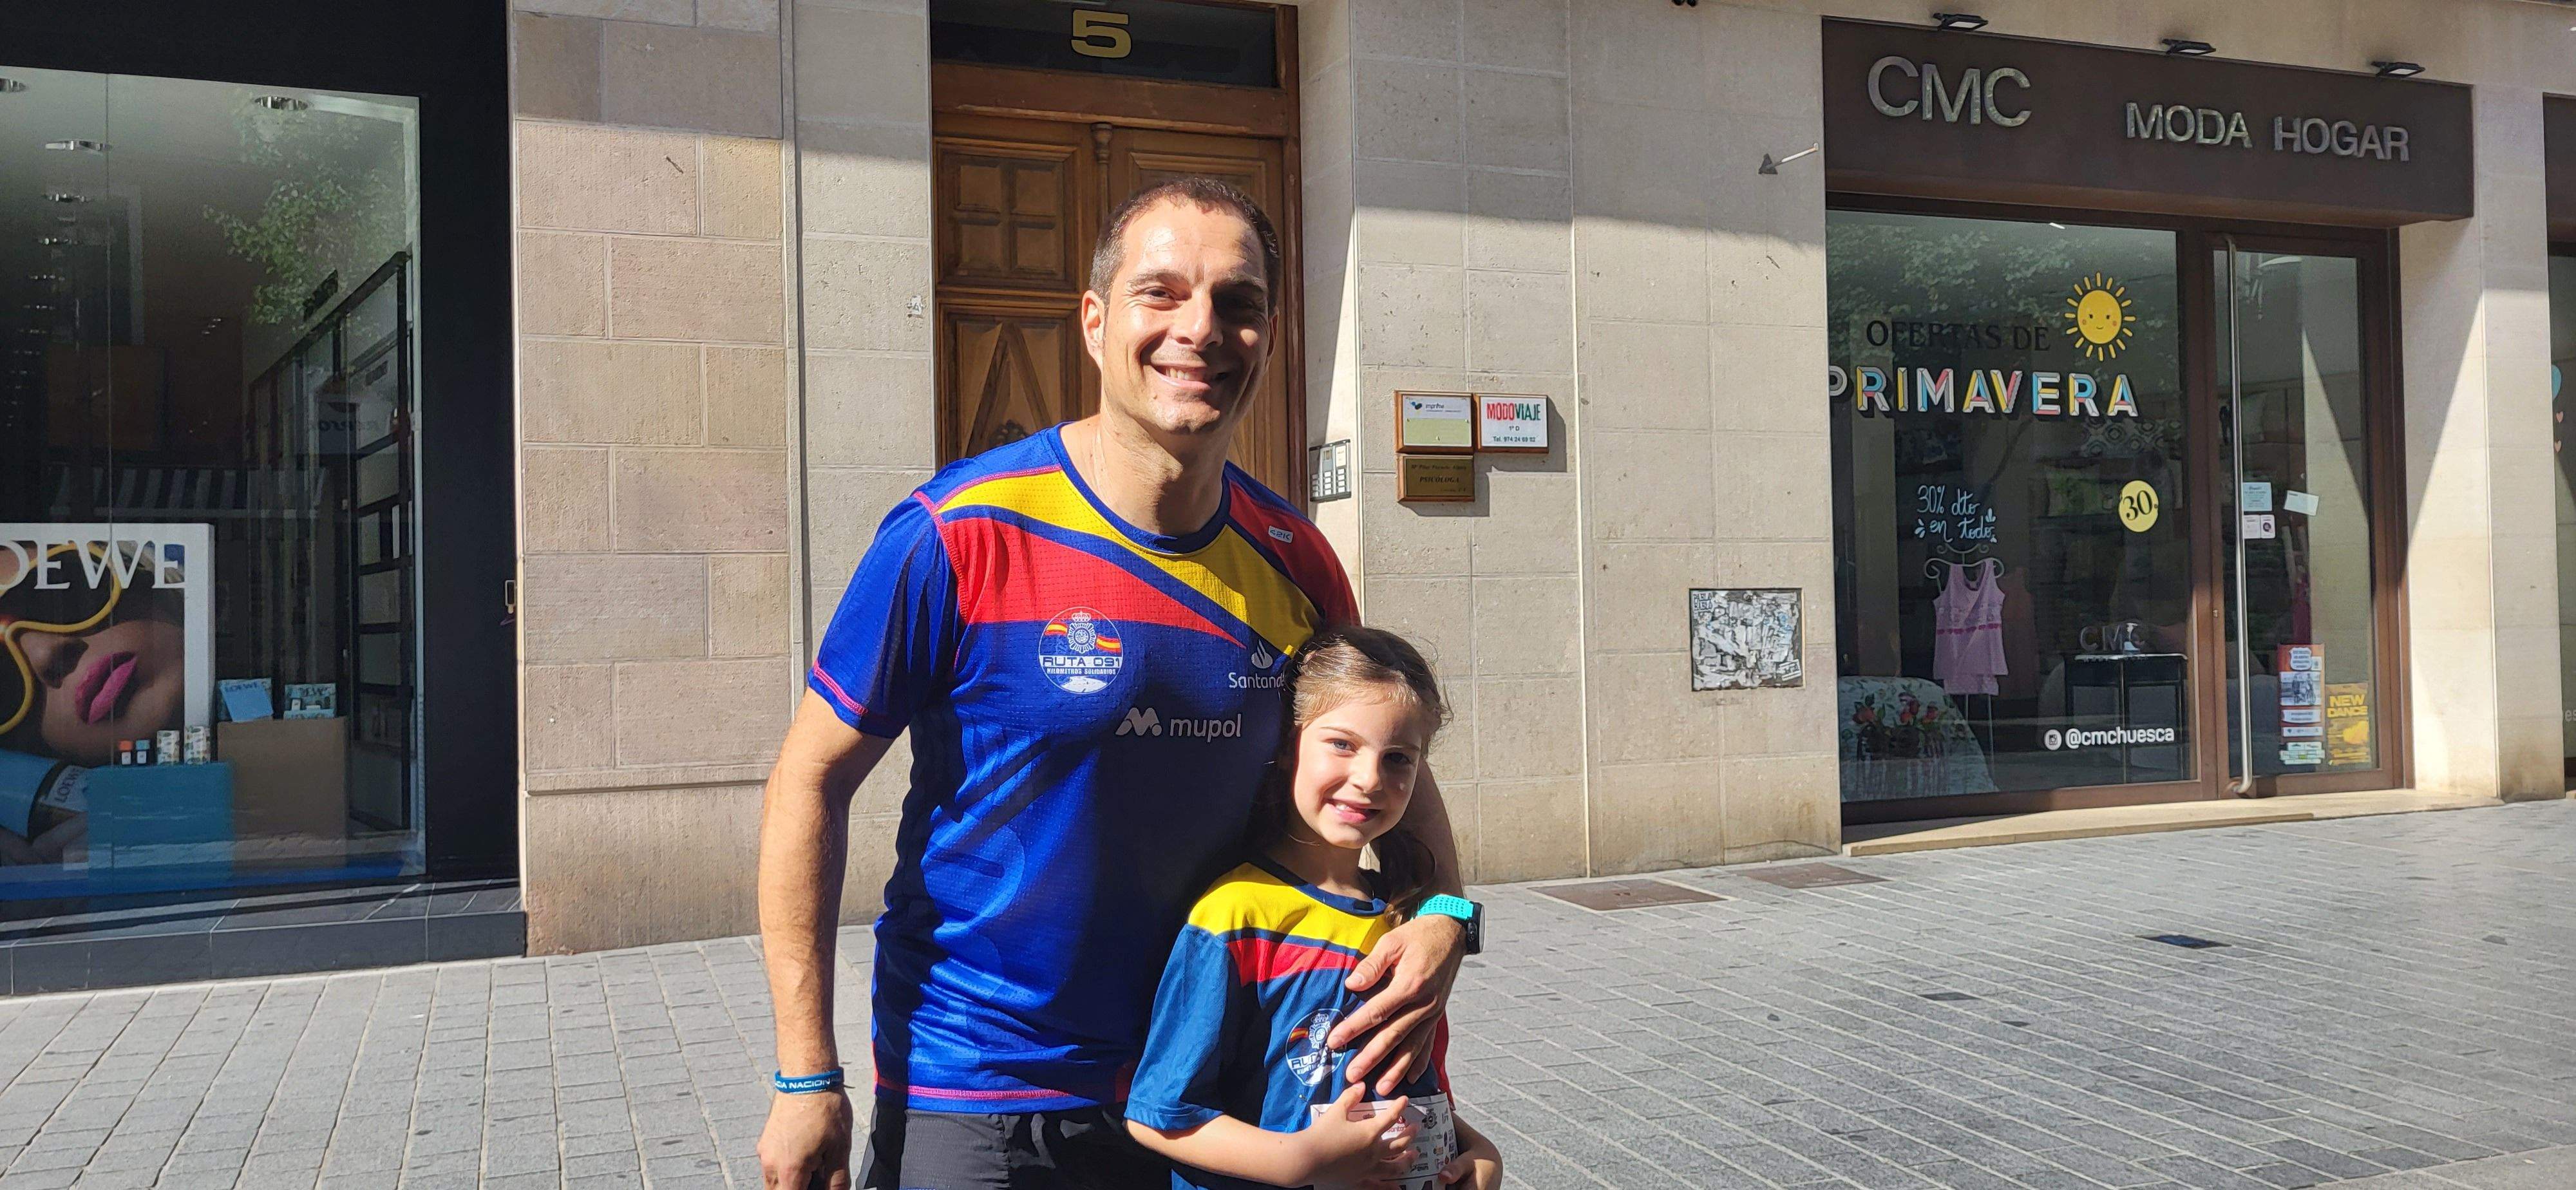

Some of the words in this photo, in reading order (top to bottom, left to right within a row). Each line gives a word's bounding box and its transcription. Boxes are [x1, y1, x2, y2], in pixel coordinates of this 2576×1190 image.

[1070, 9, 1132, 59] 5
[1868, 56, 2032, 128] CMC
[2126, 102, 2253, 148] MODA
[2273, 116, 2409, 162] HOGAR
[1866, 319, 2003, 350] OFERTAS
[2013, 326, 2051, 352] DE
[1830, 365, 2139, 418] PRIMAVERA
[1486, 402, 1541, 420] MODOVIAJE
[1917, 485, 1945, 514] 30%
[1951, 488, 1980, 515] dto
[1929, 520, 1953, 542] en
[1957, 515, 1995, 540] todo
[1043, 657, 1086, 666] RUTA
[1093, 657, 1120, 667] 091
[2327, 706, 2368, 718] DANCE
[2329, 694, 2365, 707] NEW
[1170, 713, 1242, 743] mupol
[2065, 726, 2175, 749] @cmchuesca
